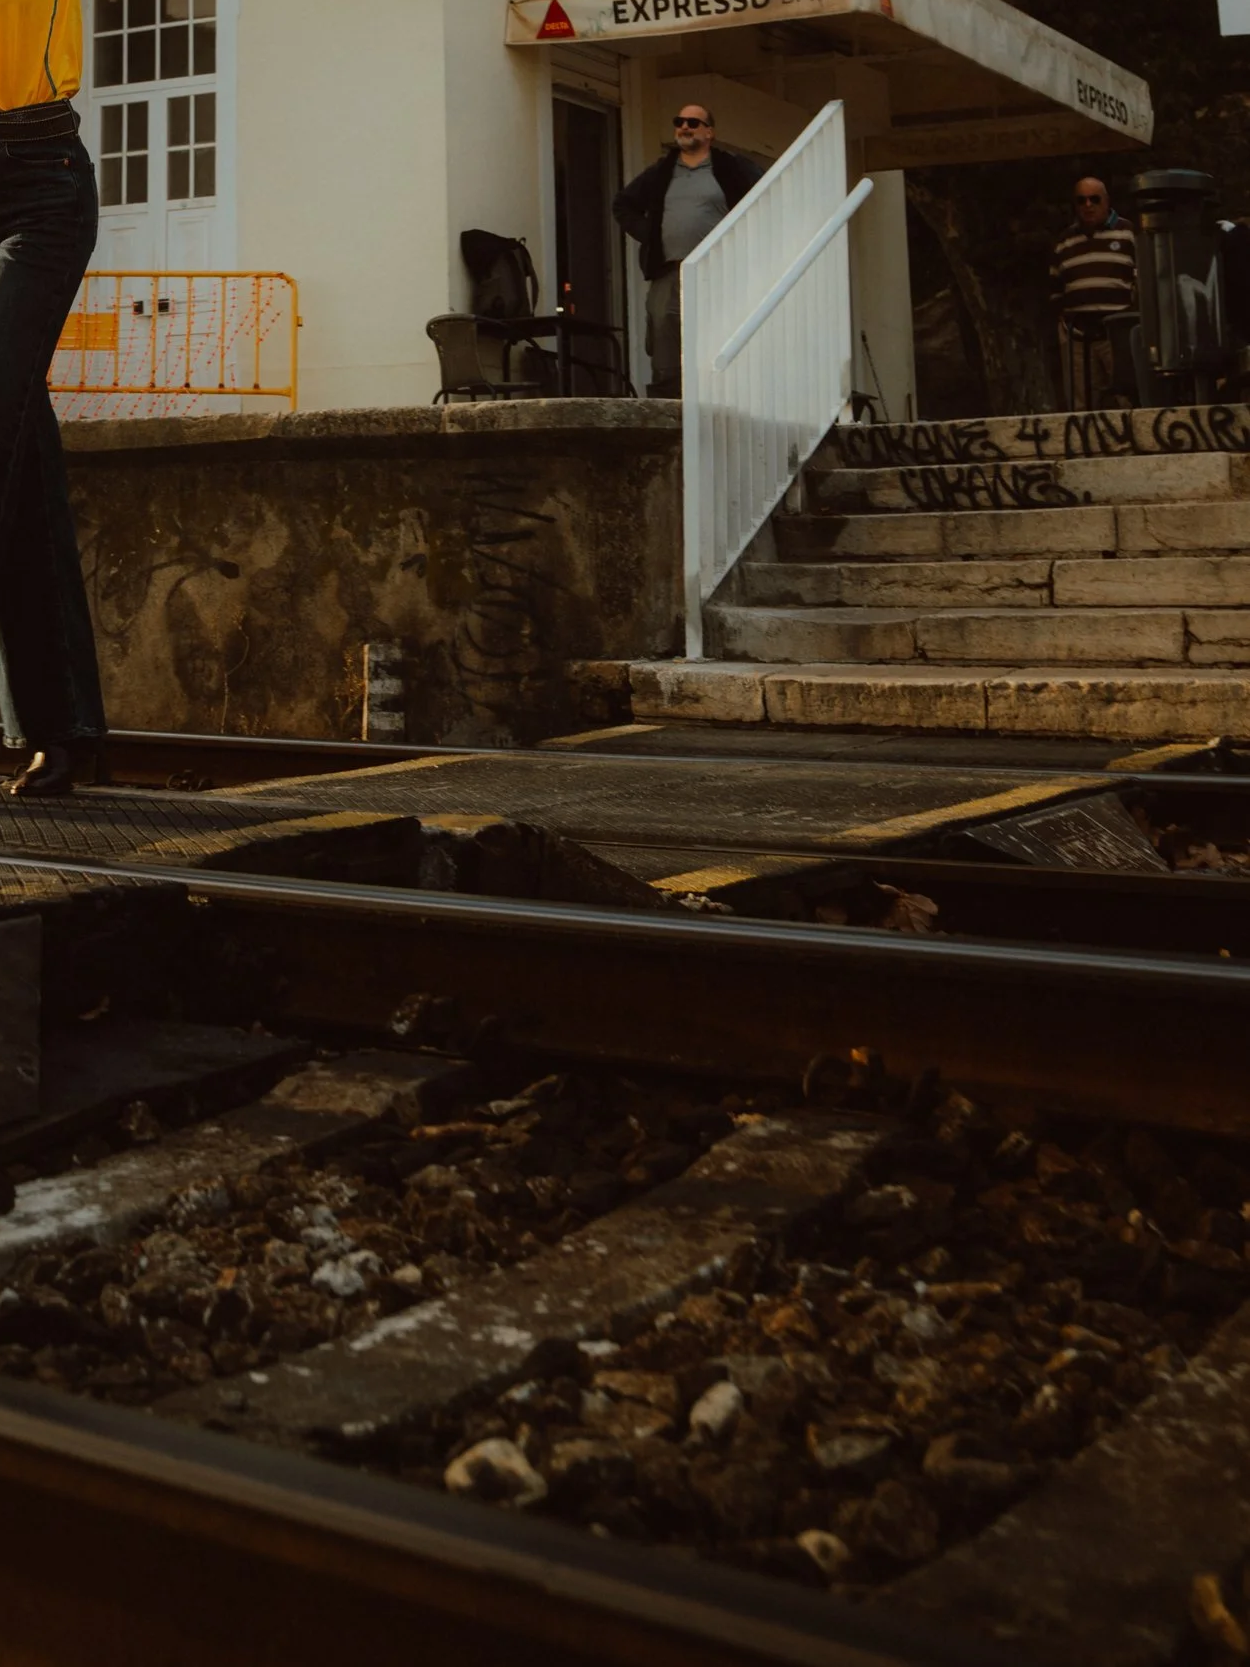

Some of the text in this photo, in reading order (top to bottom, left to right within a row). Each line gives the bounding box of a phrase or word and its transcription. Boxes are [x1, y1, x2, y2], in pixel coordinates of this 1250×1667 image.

[544, 21, 570, 31] DELTA
[1076, 78, 1128, 126] EXPRESSO
[1015, 417, 1049, 460] 4
[1064, 410, 1144, 459] MY
[1153, 404, 1250, 454] GIR
